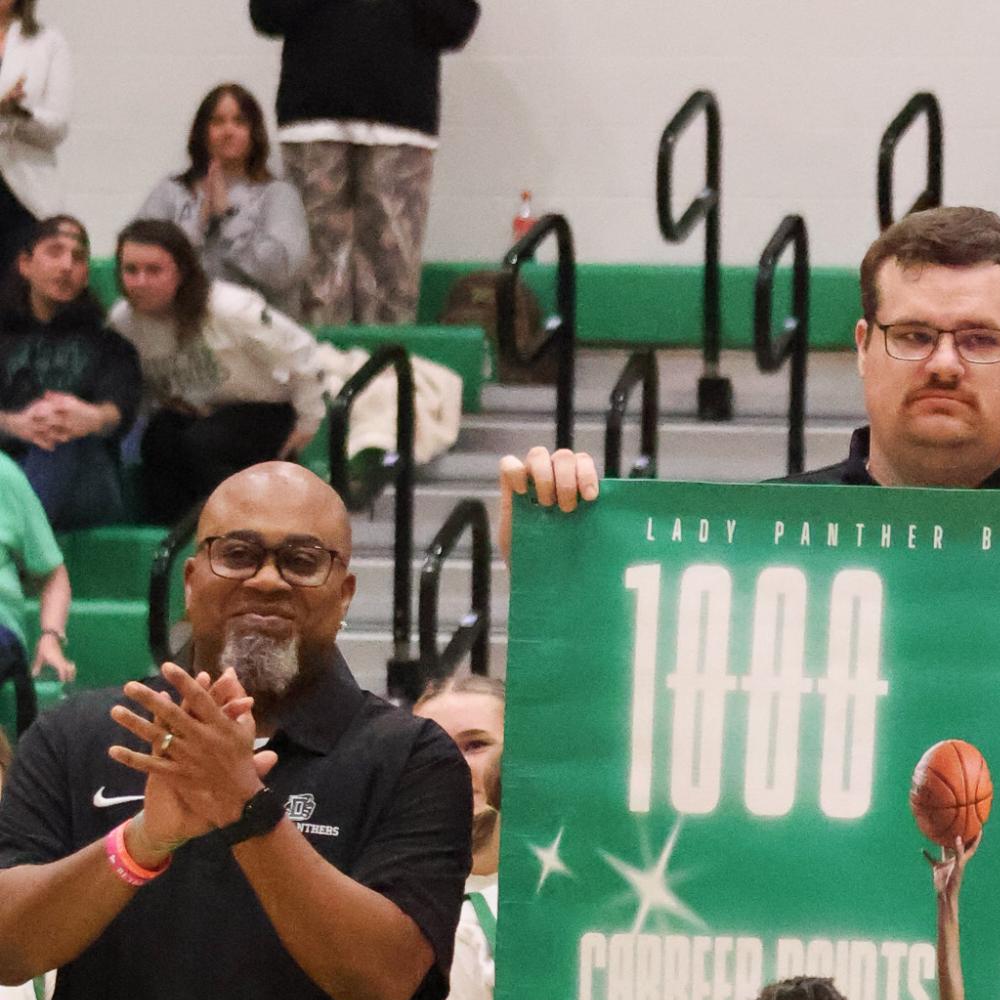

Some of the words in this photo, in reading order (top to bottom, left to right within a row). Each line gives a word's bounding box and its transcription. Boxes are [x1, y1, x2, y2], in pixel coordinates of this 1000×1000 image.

[646, 517, 737, 543] LADY
[774, 521, 944, 549] PANTHER
[624, 563, 889, 819] 1000
[296, 822, 340, 836] NTHERS
